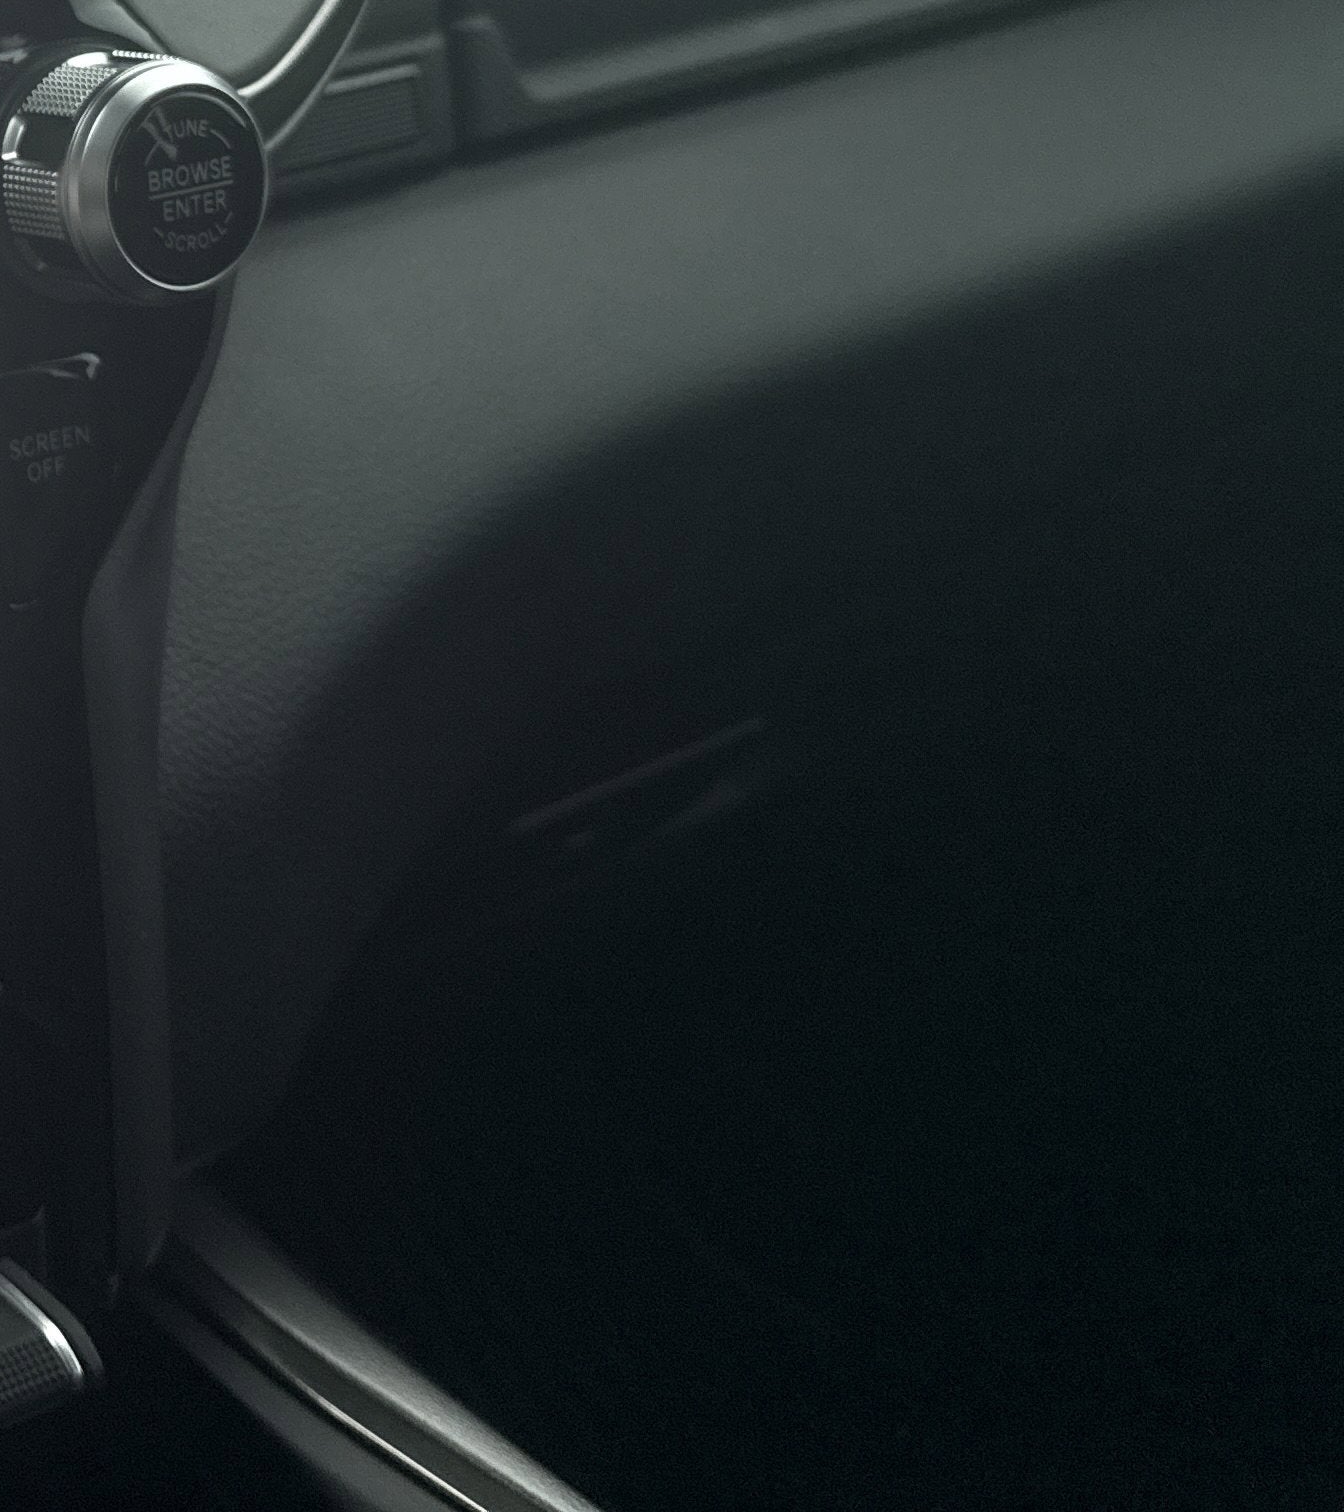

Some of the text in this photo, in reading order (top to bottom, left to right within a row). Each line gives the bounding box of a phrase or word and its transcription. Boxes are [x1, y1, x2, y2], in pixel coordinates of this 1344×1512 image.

[148, 155, 233, 190] BROWSE
[162, 192, 228, 222] ENTER
[164, 225, 228, 252] SCROLL
[10, 425, 92, 460] SCREEN
[26, 456, 66, 483] OFF
